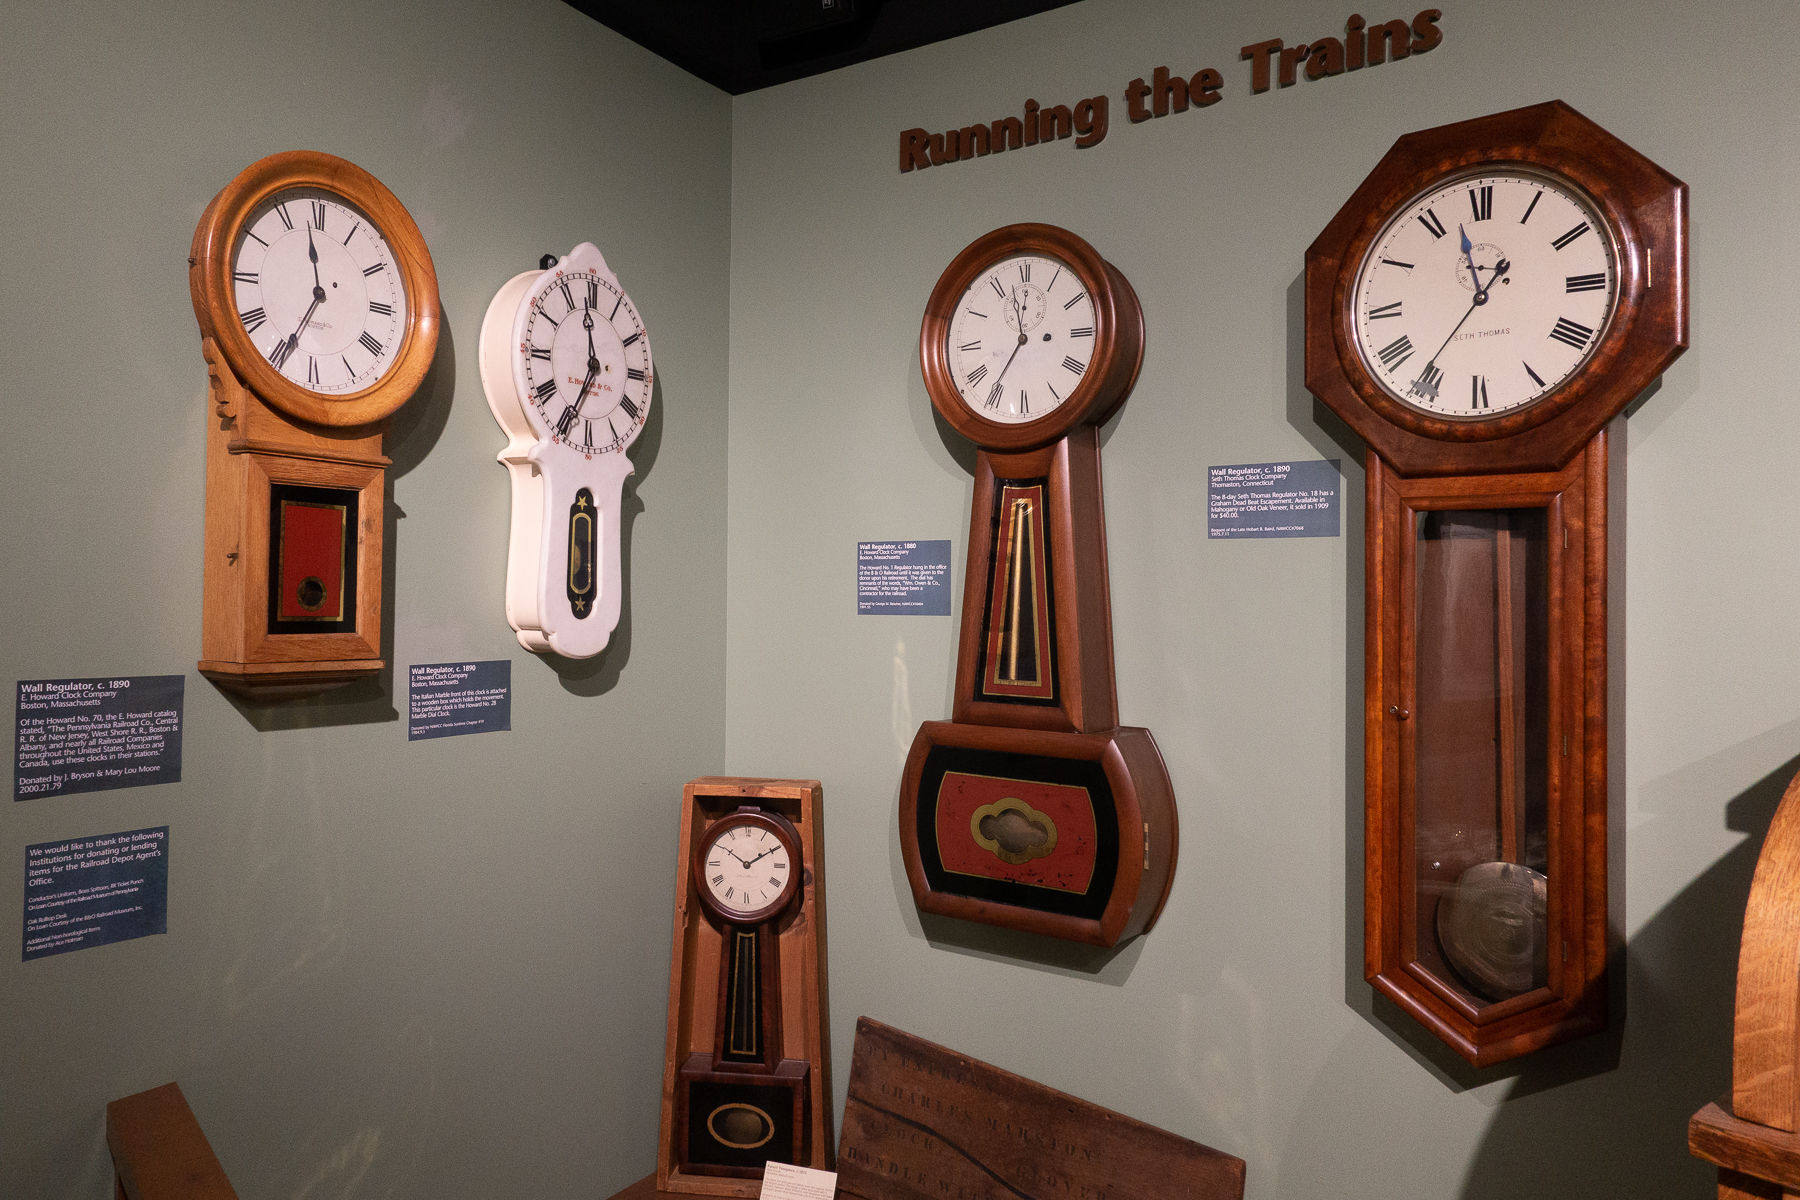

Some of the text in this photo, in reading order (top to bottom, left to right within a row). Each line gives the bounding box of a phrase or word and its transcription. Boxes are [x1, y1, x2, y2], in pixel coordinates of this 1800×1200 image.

[900, 8, 1443, 174] Running the Trains
[1454, 328, 1510, 342] SETH THOMAS
[1228, 467, 1263, 477] Regulator,
[1273, 465, 1290, 473] 1890
[1261, 473, 1287, 481] Company
[1260, 498, 1293, 506] Escapement.
[1272, 491, 1297, 499] Regulator
[1211, 506, 1238, 514] Mahogany
[426, 666, 455, 675] Regulator,
[21, 684, 43, 692] Wall
[46, 682, 94, 694] Regulator,
[83, 690, 117, 700] Company
[21, 699, 101, 710] Boston, Massachusetts
[46, 716, 76, 724] Howard
[154, 710, 177, 719] catalog
[20, 727, 45, 736] stated,
[67, 722, 111, 733] Pennsylvania
[113, 720, 139, 728] Railroad
[141, 719, 154, 727] Co.,
[49, 733, 66, 741] New
[68, 732, 90, 741] Jersey,
[139, 727, 147, 735] R.,
[20, 743, 47, 753] Albany,
[65, 740, 86, 749] nearly
[98, 737, 125, 745] Railroad
[127, 734, 163, 744] Companies
[19, 750, 62, 762] throughout
[78, 747, 101, 755] United
[103, 745, 124, 753] States,
[126, 742, 150, 750] Mexico
[19, 759, 50, 770] Canada,
[66, 756, 85, 764] these
[87, 754, 108, 762] clocks
[134, 749, 163, 757] stations."
[19, 776, 51, 785] Donated
[53, 775, 63, 784] by
[71, 771, 95, 782] Bryson
[105, 768, 123, 778] Mary
[139, 764, 161, 772] Moore
[20, 782, 62, 794] 2000.21.79
[30, 831, 164, 857] We would like to thank the following
[29, 854, 72, 867] Institutions
[74, 852, 85, 860] for
[86, 847, 120, 860] donating
[131, 841, 157, 853] lending
[29, 850, 161, 877] items for the Railroad Depot Agent's
[29, 876, 54, 887] Office.
